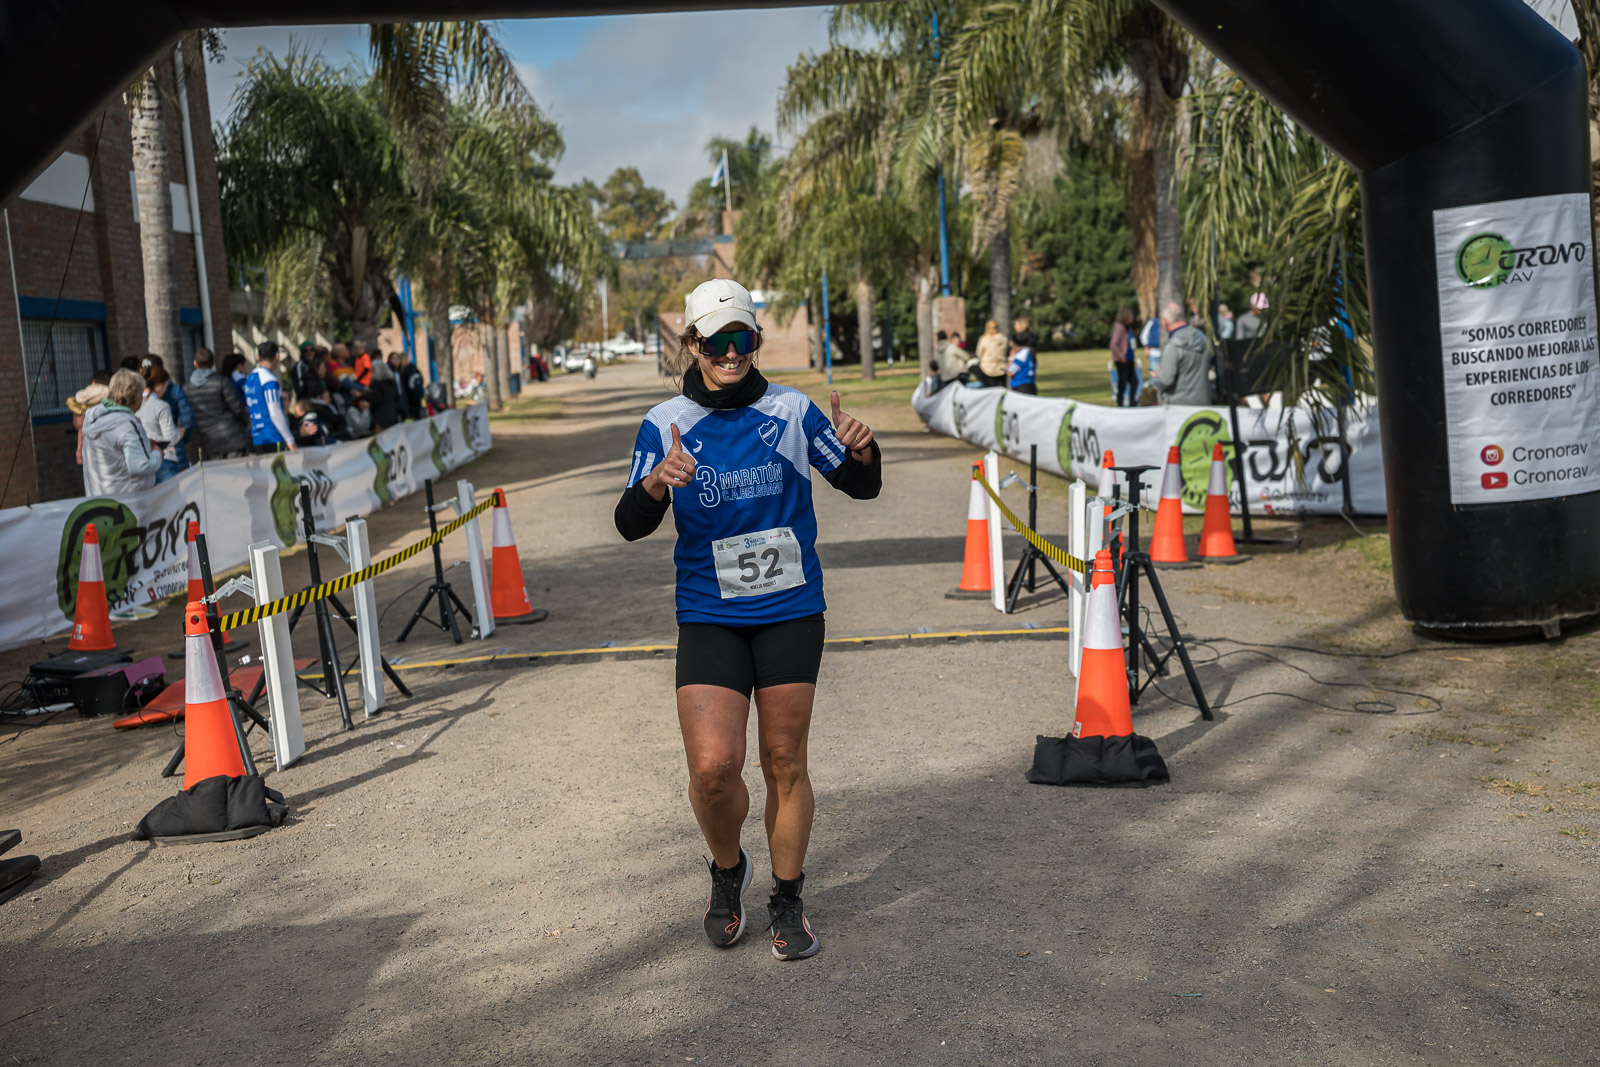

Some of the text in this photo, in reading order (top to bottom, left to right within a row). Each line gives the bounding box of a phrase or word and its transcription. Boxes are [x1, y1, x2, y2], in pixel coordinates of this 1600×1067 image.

[1498, 242, 1586, 270] CRONO
[1497, 271, 1534, 285] RAV
[1518, 316, 1587, 337] CORREDORES
[1451, 337, 1595, 366] BUSCANDO MEJORAR LAS
[1465, 360, 1589, 386] EXPERIENCIAS DE LOS
[1512, 443, 1588, 462] Cronorav
[696, 461, 783, 508] 3 MARATÓN
[1514, 465, 1589, 485] Cronorav
[744, 537, 751, 549] 3
[738, 547, 784, 583] 52
